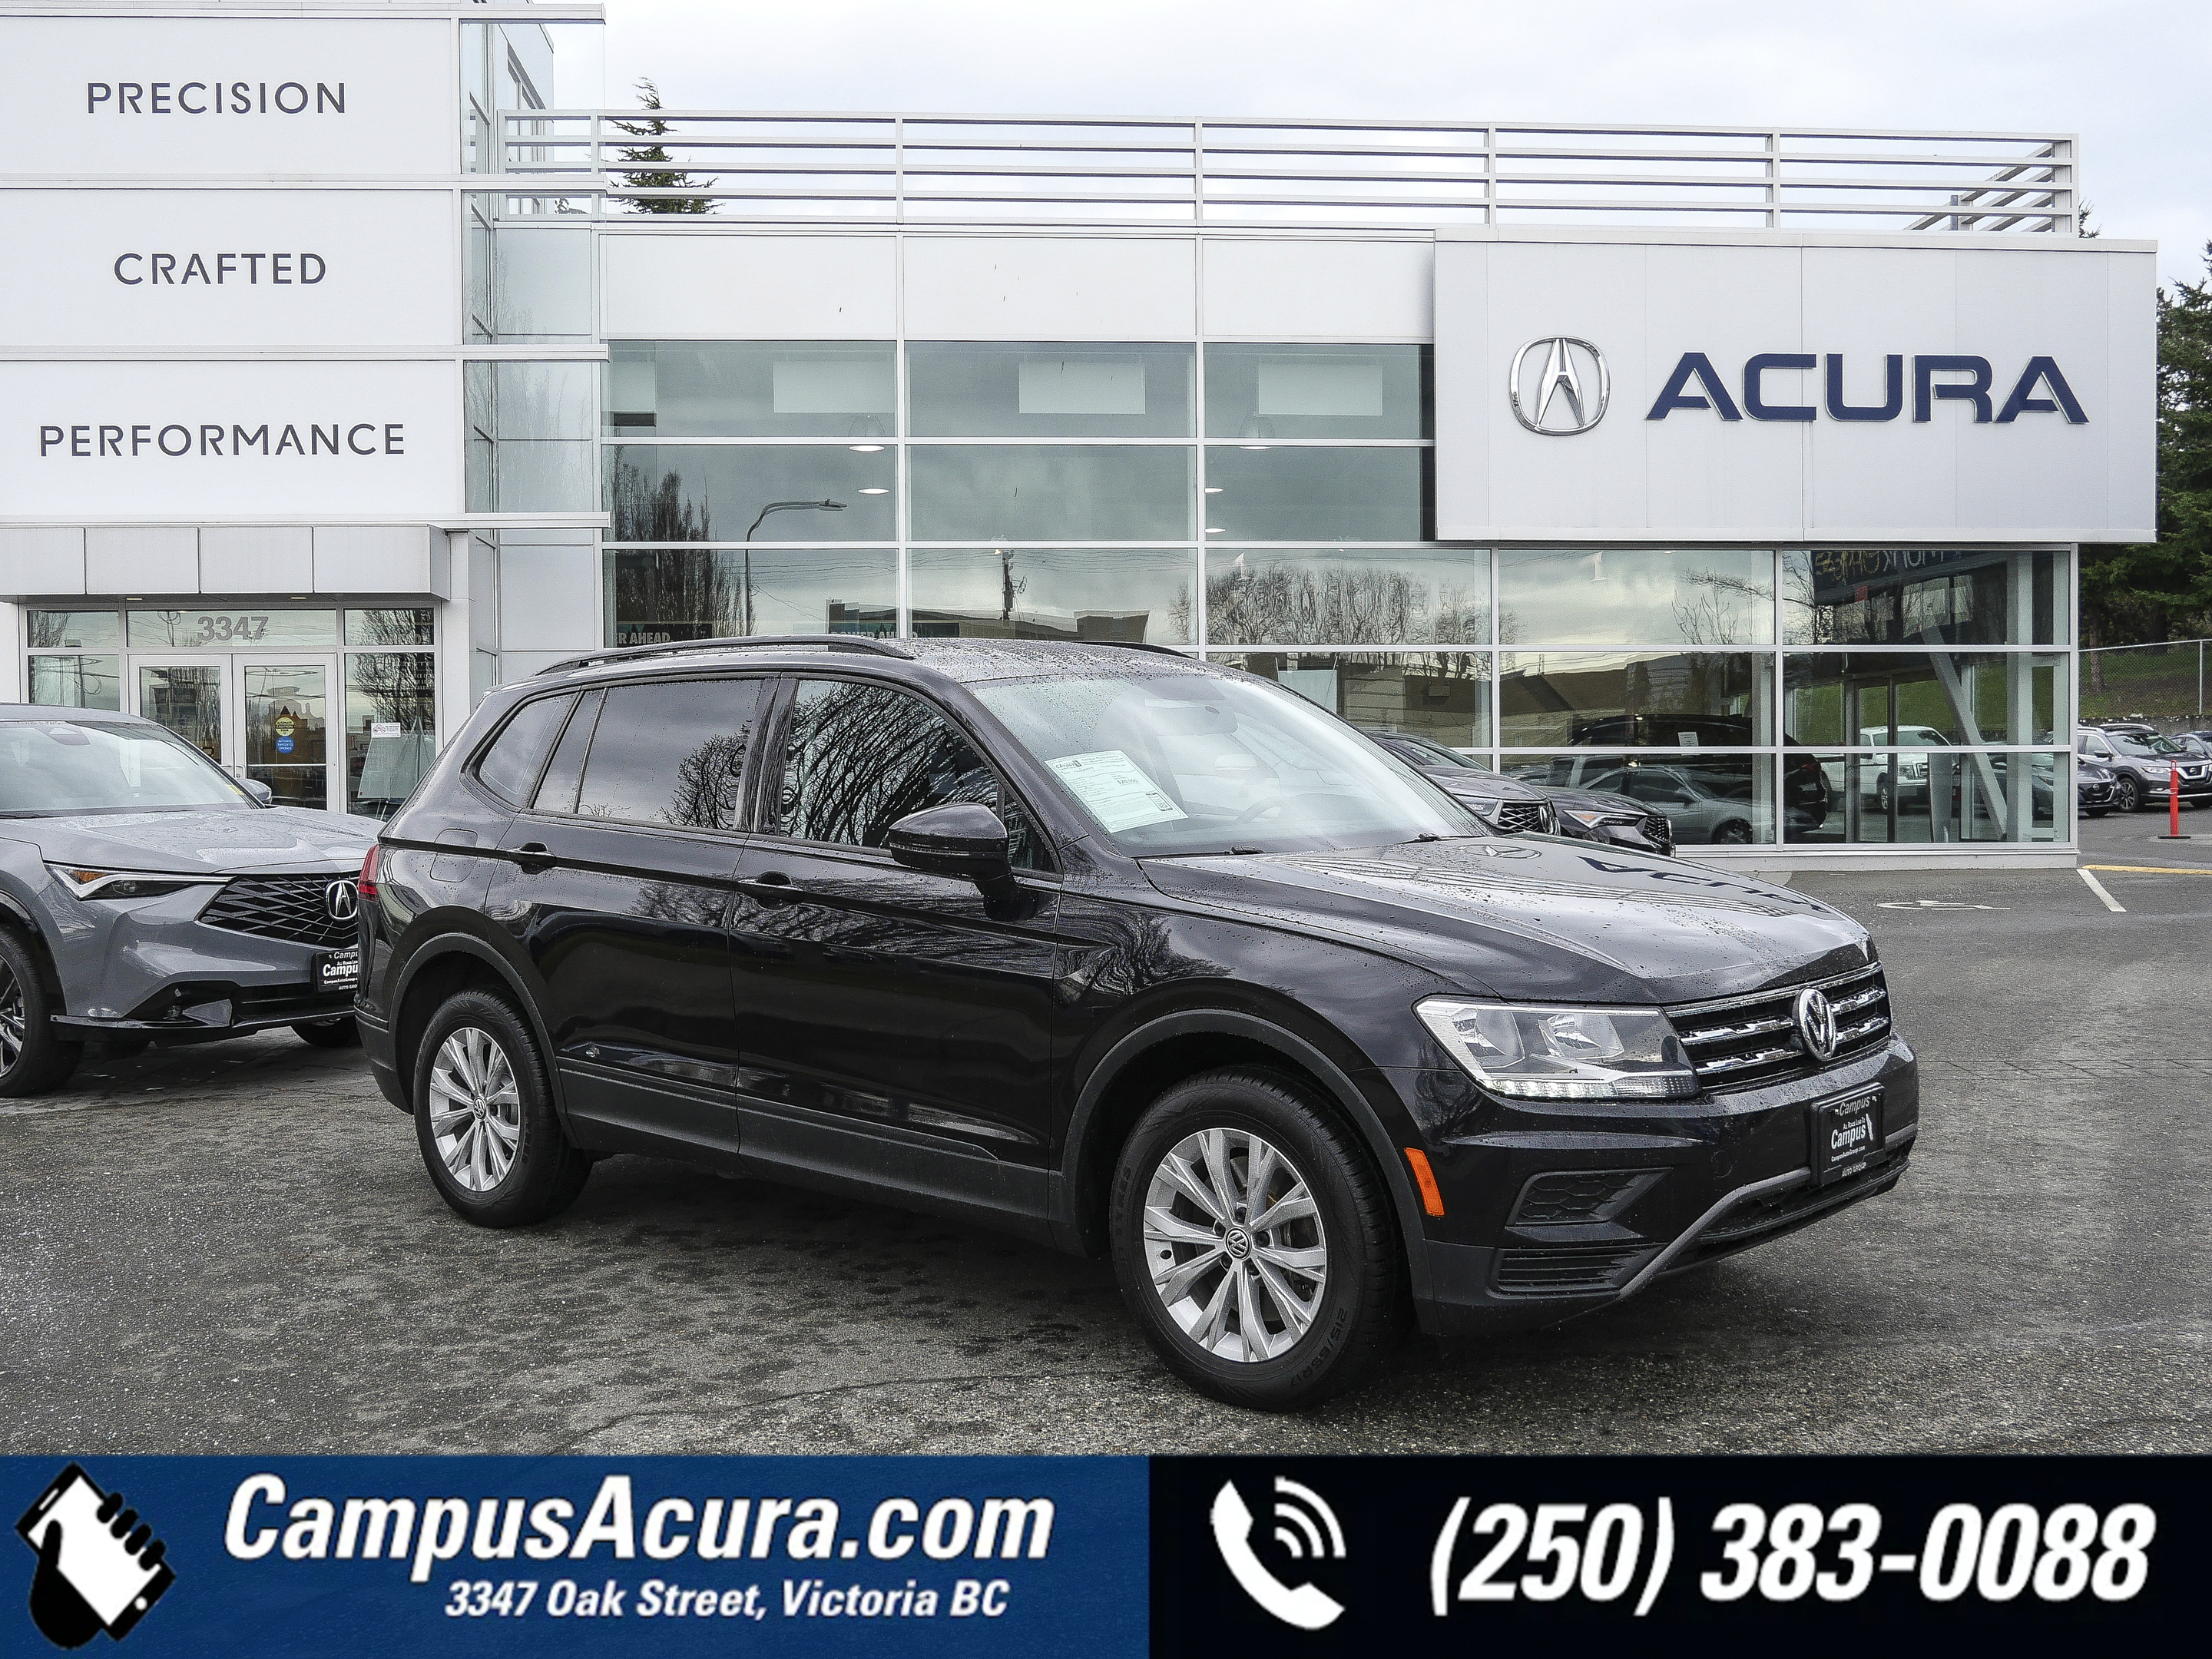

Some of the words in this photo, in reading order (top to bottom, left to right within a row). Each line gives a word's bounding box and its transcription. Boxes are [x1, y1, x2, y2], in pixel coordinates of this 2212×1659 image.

[87, 81, 346, 114] PRECISION
[114, 253, 326, 285] CRAFTED
[1645, 352, 2090, 426] ACURA
[40, 423, 405, 457] PERFORMANCE
[197, 616, 269, 641] 3347
[1839, 1096, 1870, 1116] Campus
[1831, 1124, 1866, 1150] Campus
